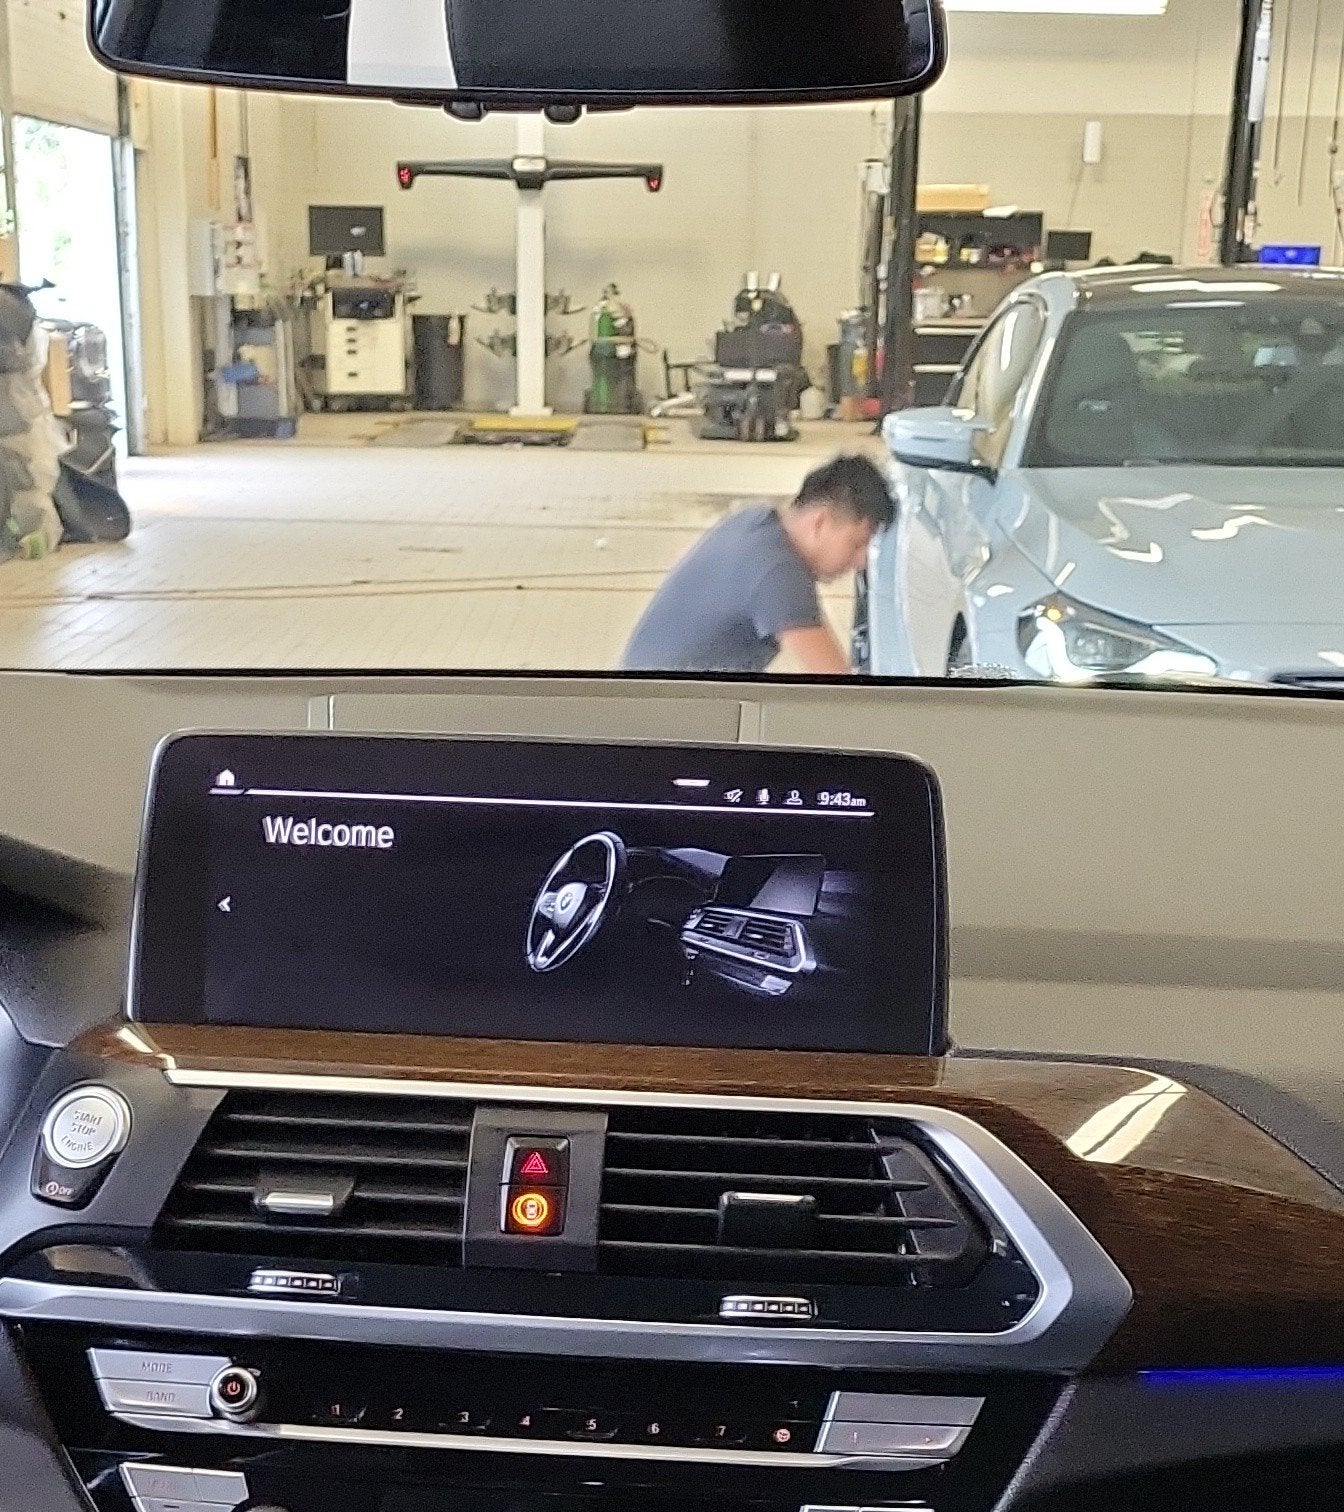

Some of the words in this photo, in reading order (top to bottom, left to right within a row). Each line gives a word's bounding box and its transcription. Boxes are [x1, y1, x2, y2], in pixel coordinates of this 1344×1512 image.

[262, 815, 395, 849] Welcome
[74, 1110, 103, 1126] START
[70, 1122, 97, 1136] STOP
[60, 1134, 95, 1153] ENGINE
[141, 1361, 174, 1375] MODE
